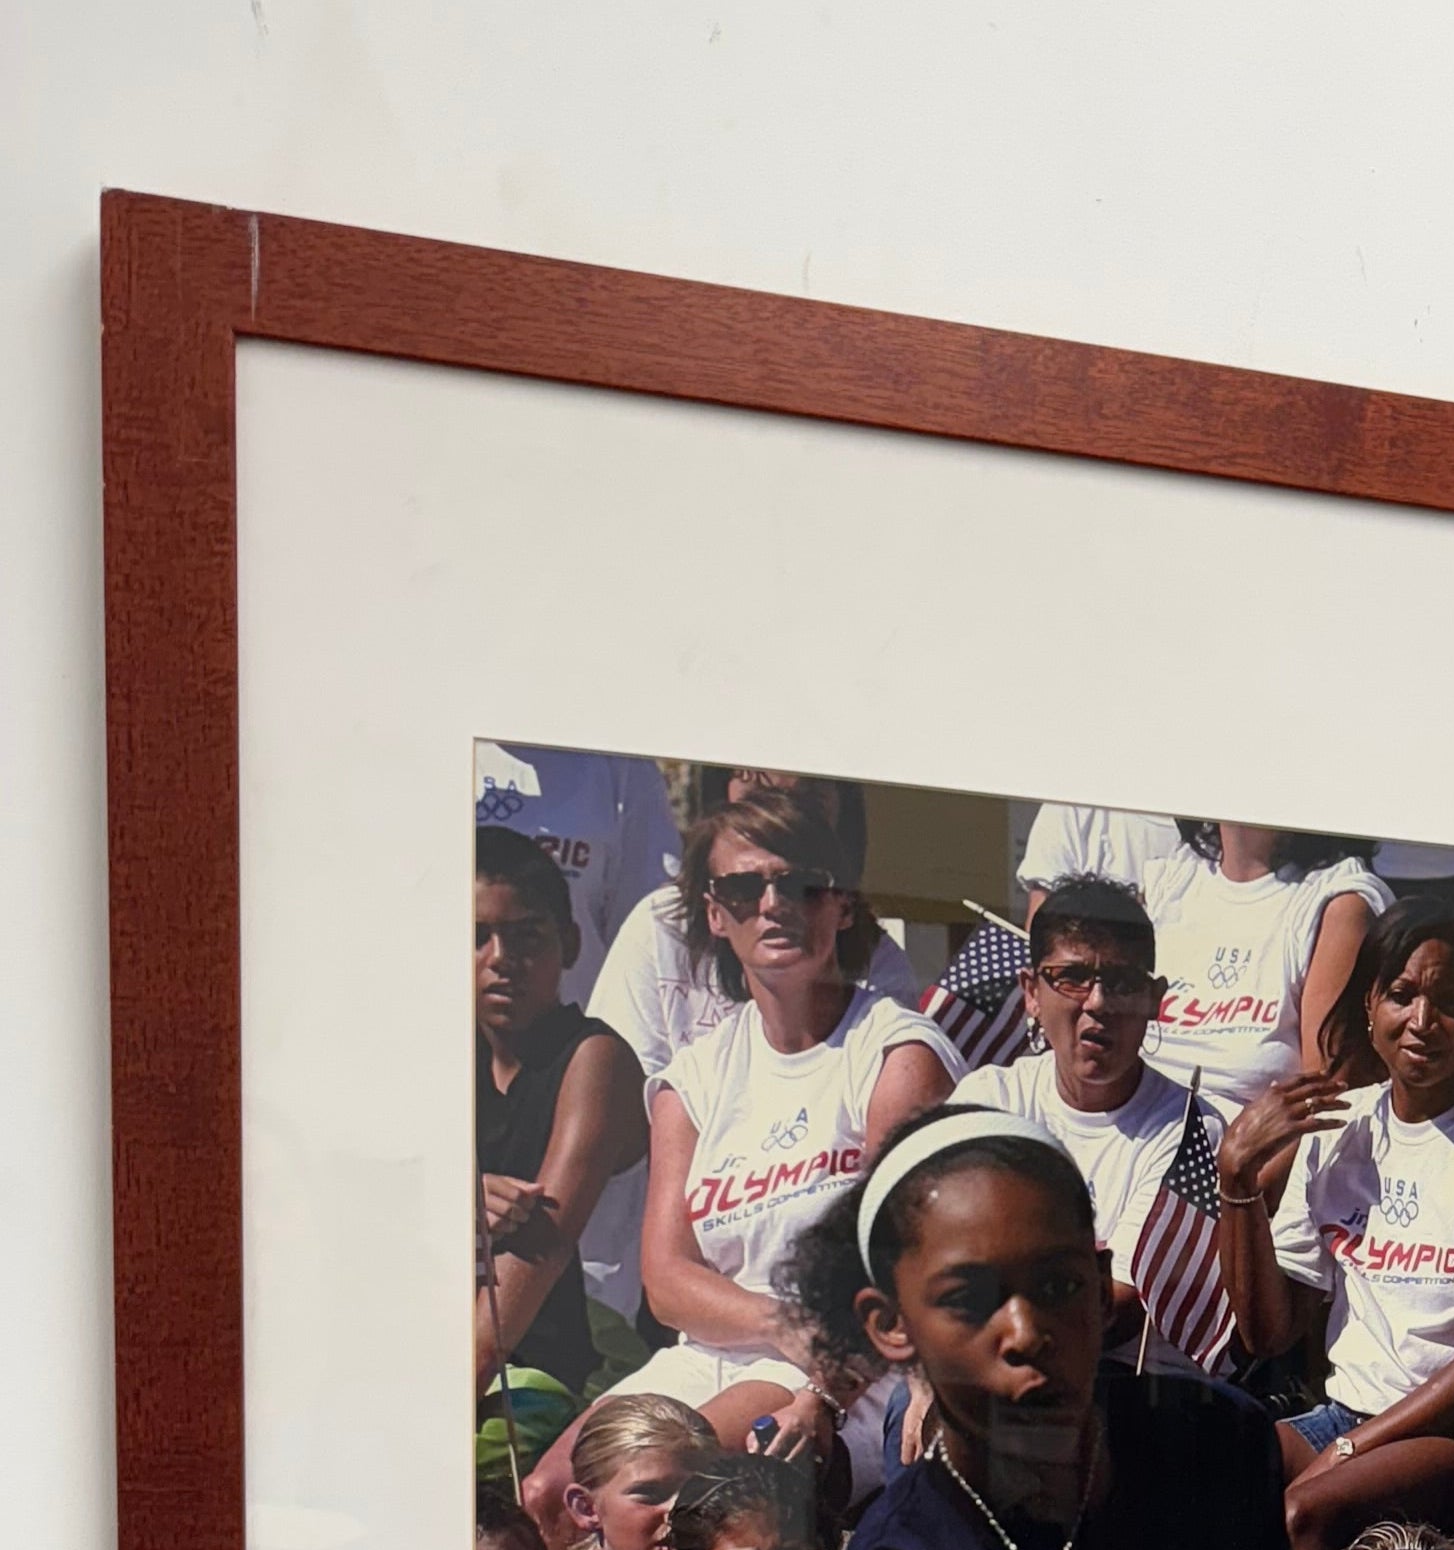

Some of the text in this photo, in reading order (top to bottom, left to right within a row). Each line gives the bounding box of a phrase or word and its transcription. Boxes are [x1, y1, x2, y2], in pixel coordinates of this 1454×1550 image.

[483, 776, 517, 791] SA
[1158, 995, 1279, 1027] LYMPIC
[688, 1148, 862, 1222] OLYMPIC
[1384, 1177, 1418, 1199] USA
[703, 1203, 764, 1232] SKILLS
